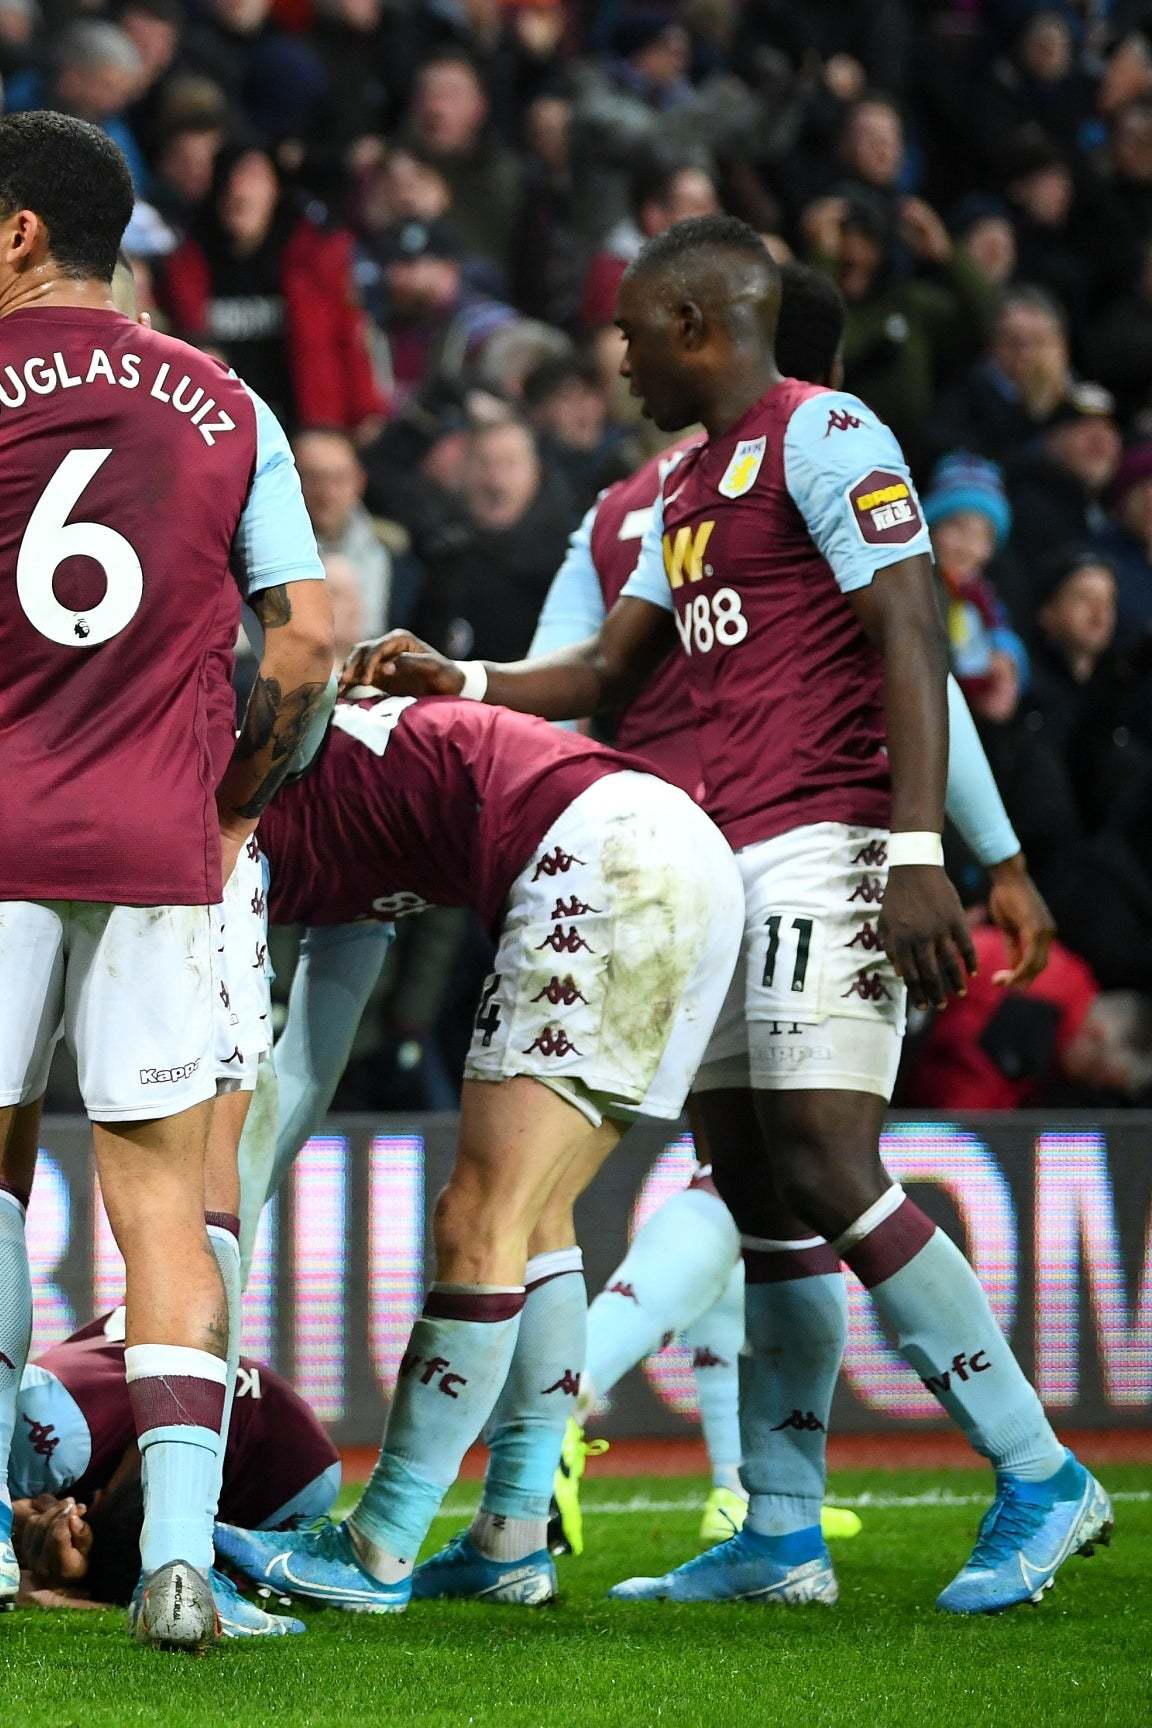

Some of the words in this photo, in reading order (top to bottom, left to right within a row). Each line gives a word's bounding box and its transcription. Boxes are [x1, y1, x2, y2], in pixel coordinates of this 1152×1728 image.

[150, 362, 236, 446] LUIZ
[16, 448, 144, 647] 6
[763, 915, 814, 993] 11
